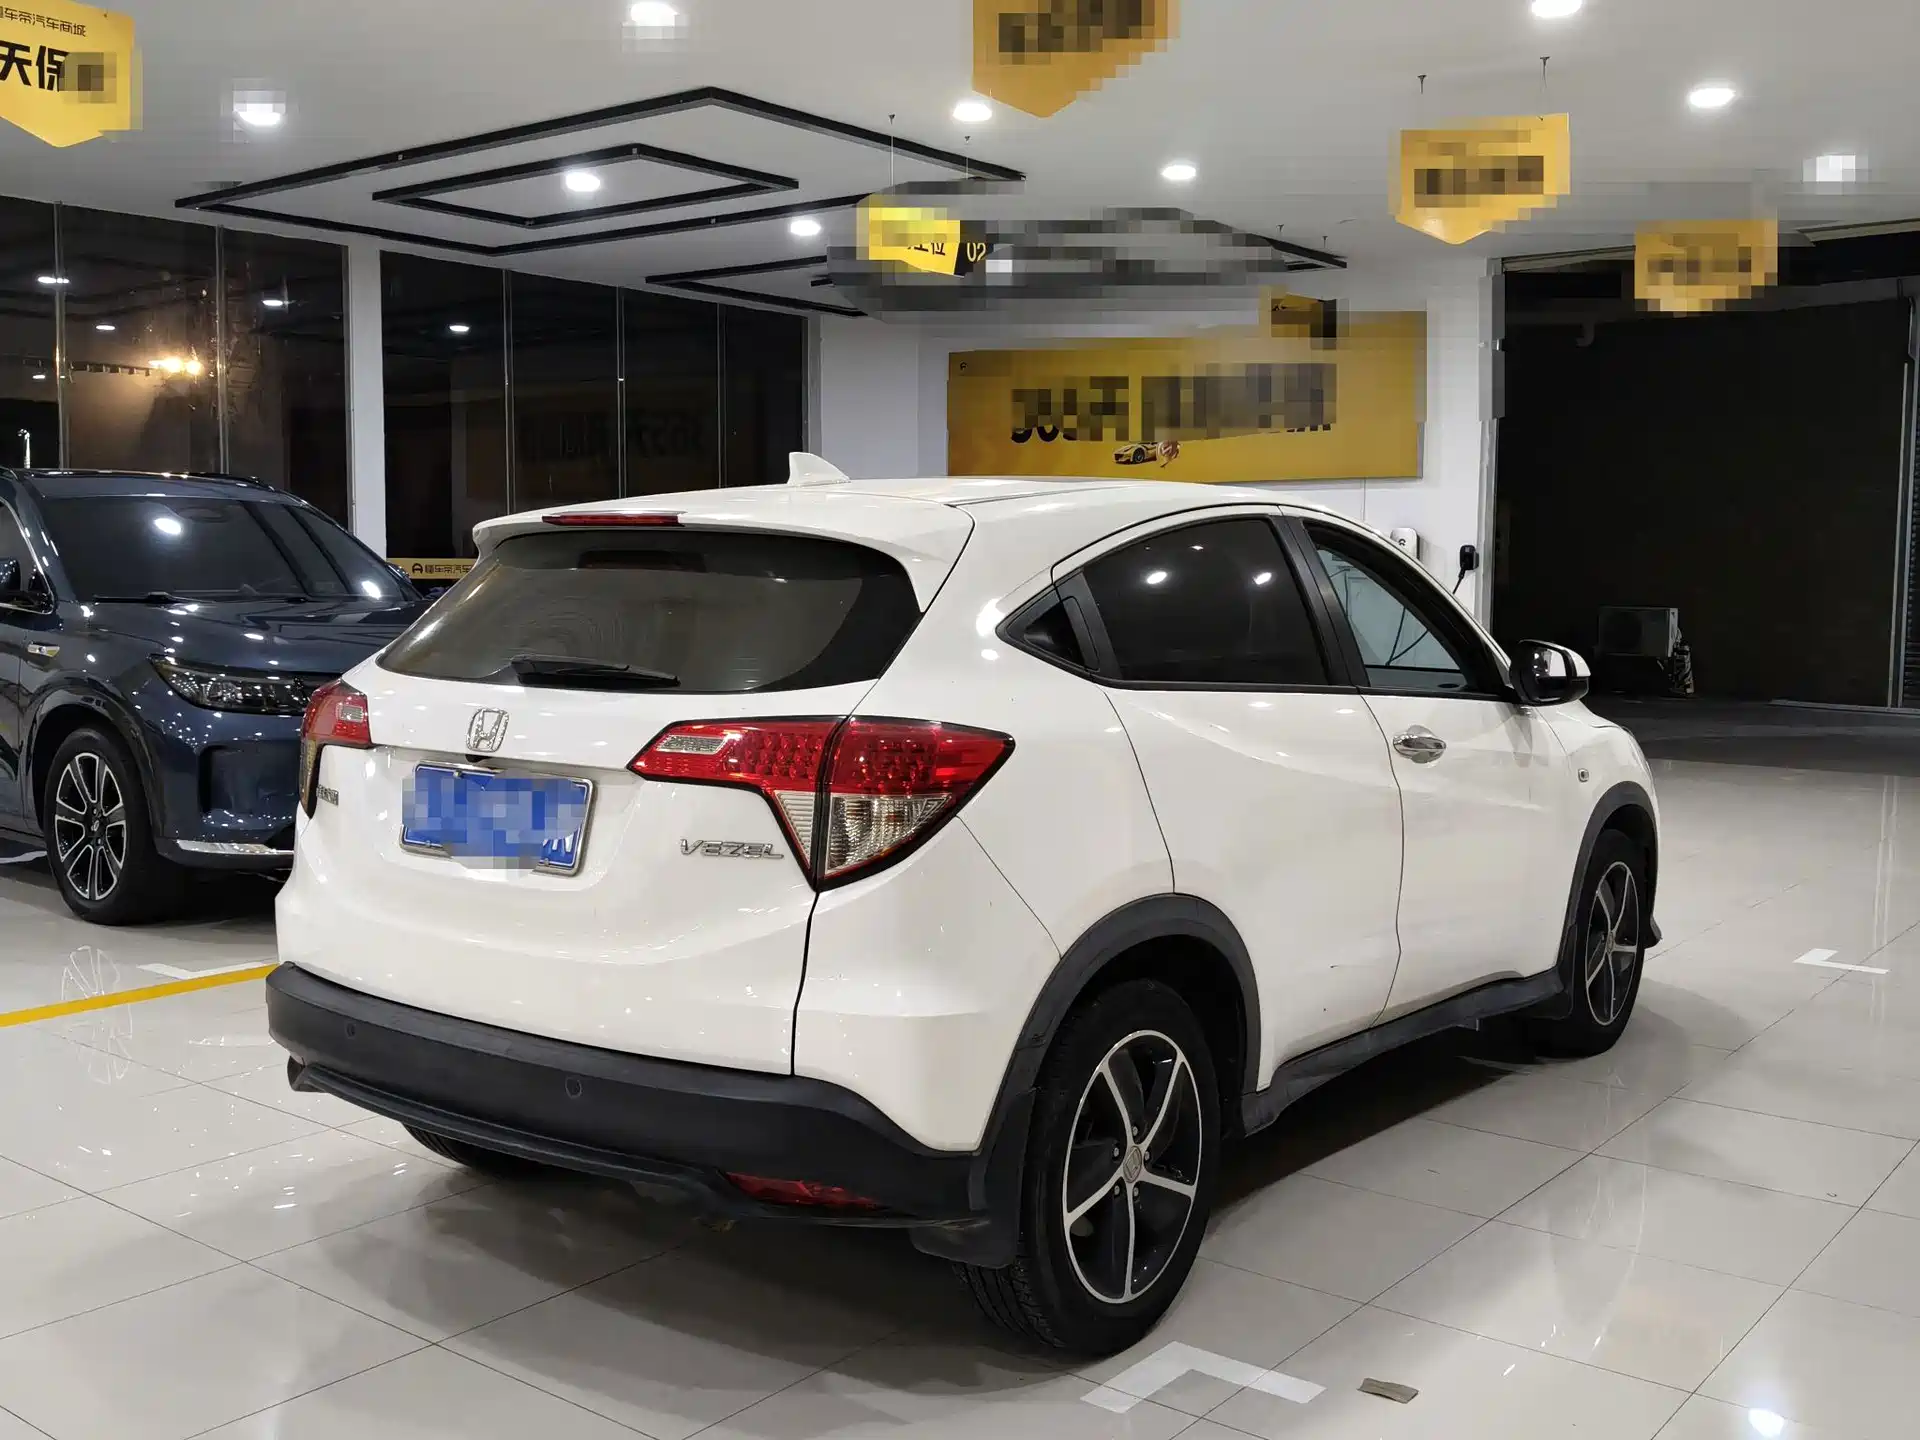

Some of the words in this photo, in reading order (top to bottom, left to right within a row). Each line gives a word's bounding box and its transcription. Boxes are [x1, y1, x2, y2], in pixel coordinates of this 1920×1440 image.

[0, 6, 87, 37] 车帝汽车商城
[680, 839, 784, 860] VEZEL
